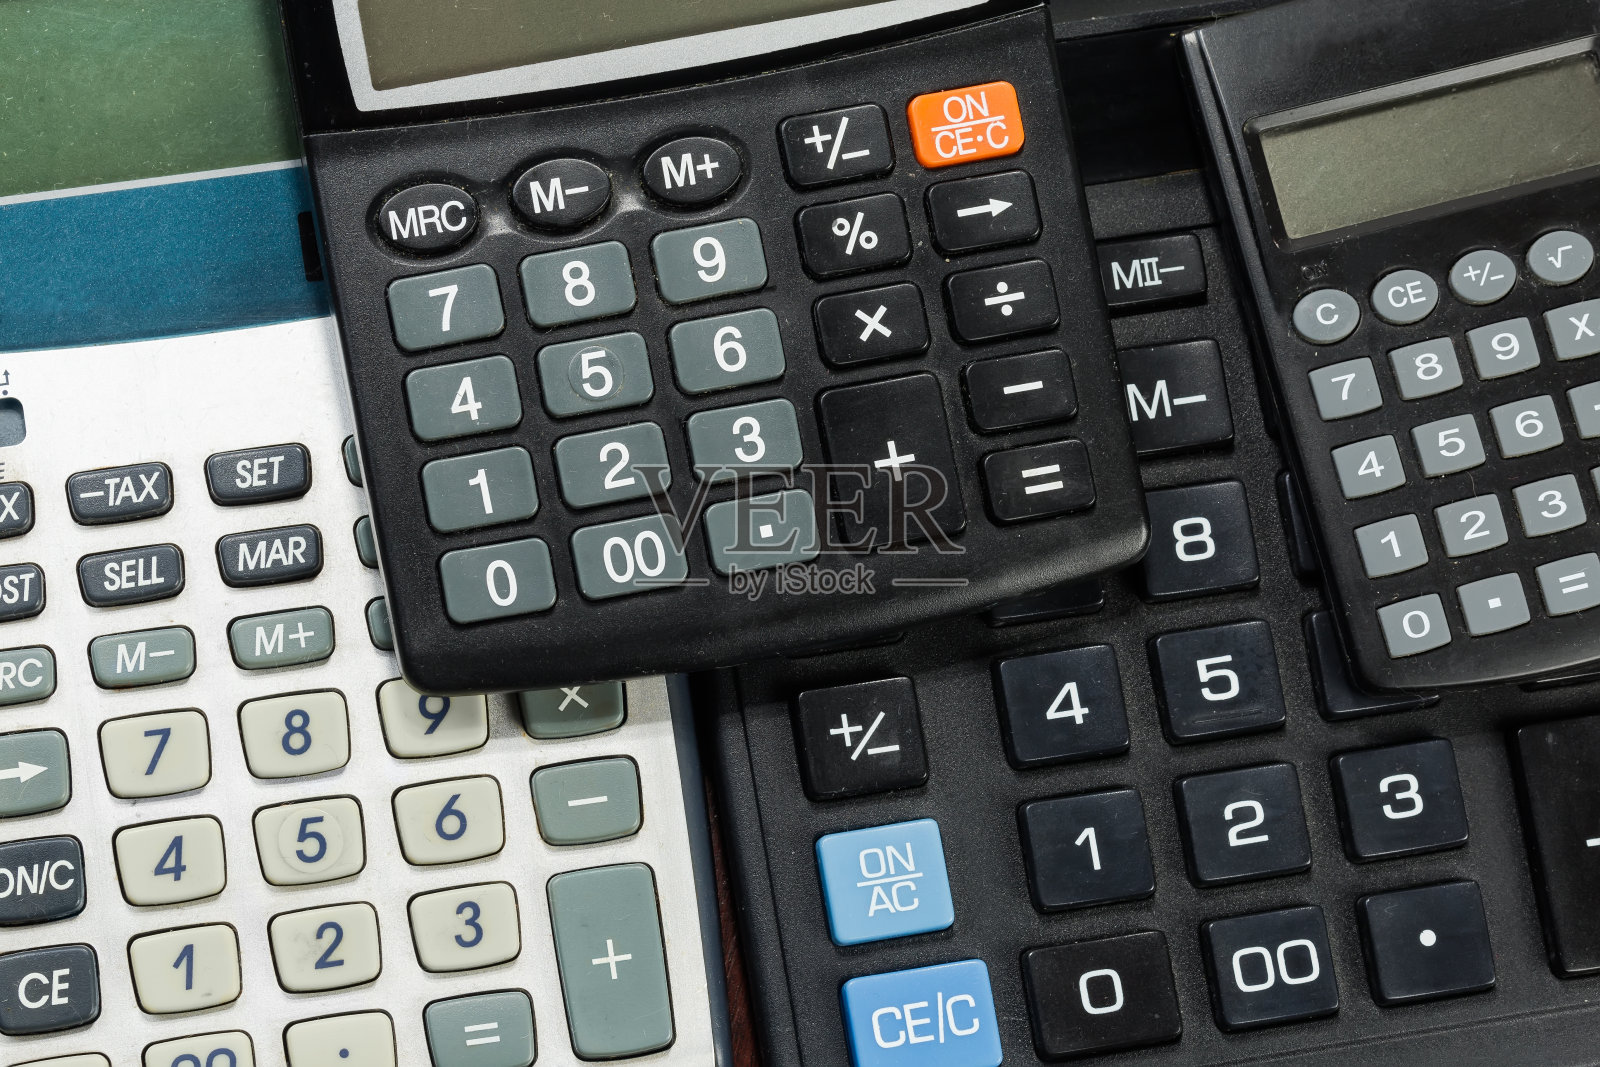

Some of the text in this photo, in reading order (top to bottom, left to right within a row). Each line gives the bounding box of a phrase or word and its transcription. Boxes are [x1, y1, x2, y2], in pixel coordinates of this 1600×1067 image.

[943, 91, 989, 124] ON
[661, 153, 719, 189] M+
[530, 178, 589, 214] M-
[388, 200, 467, 240] MRC
[693, 237, 726, 283] 9
[562, 260, 596, 306] 8
[1387, 280, 1426, 309] CE
[428, 284, 459, 331] 7
[1315, 303, 1339, 325] C
[713, 326, 747, 372] 6
[1416, 352, 1443, 381] 8
[1491, 333, 1520, 360] 9
[580, 350, 613, 397] 5
[1331, 373, 1356, 401] 7
[450, 376, 482, 421] 4
[1126, 379, 1207, 422] M-
[732, 416, 766, 462] 3
[1437, 428, 1466, 457] 5
[1515, 410, 1544, 438] 6
[236, 455, 284, 489] SET
[599, 442, 635, 489] 2
[1357, 450, 1385, 478] 4
[468, 468, 494, 514] 1
[1537, 490, 1567, 518] 3
[1172, 515, 1216, 563] 8
[1380, 531, 1401, 558] 1
[1459, 511, 1490, 541] 2
[104, 556, 164, 591] SELL
[238, 536, 306, 571] MAR
[603, 530, 666, 583] 00
[486, 559, 518, 606] 0
[255, 622, 314, 656] M+
[1402, 610, 1430, 638] 0
[116, 642, 175, 674] M-
[1196, 654, 1240, 701] 5
[419, 697, 450, 734] 9
[1046, 681, 1089, 725] 4
[144, 727, 172, 775] 7
[282, 709, 312, 755] 8
[435, 794, 467, 840] 6
[1379, 773, 1424, 819] 3
[296, 816, 327, 863] 5
[1224, 800, 1269, 847] 2
[154, 835, 186, 881] 4
[859, 842, 915, 879] ON
[1074, 826, 1101, 871] 1
[0, 860, 74, 898] ON/C
[868, 882, 919, 917] AC
[315, 922, 344, 969] 2
[454, 901, 484, 947] 3
[173, 944, 193, 990] 1
[1232, 938, 1320, 992] 00
[18, 968, 70, 1009] CE
[1079, 968, 1125, 1015] 0
[871, 992, 980, 1049] CE/C
